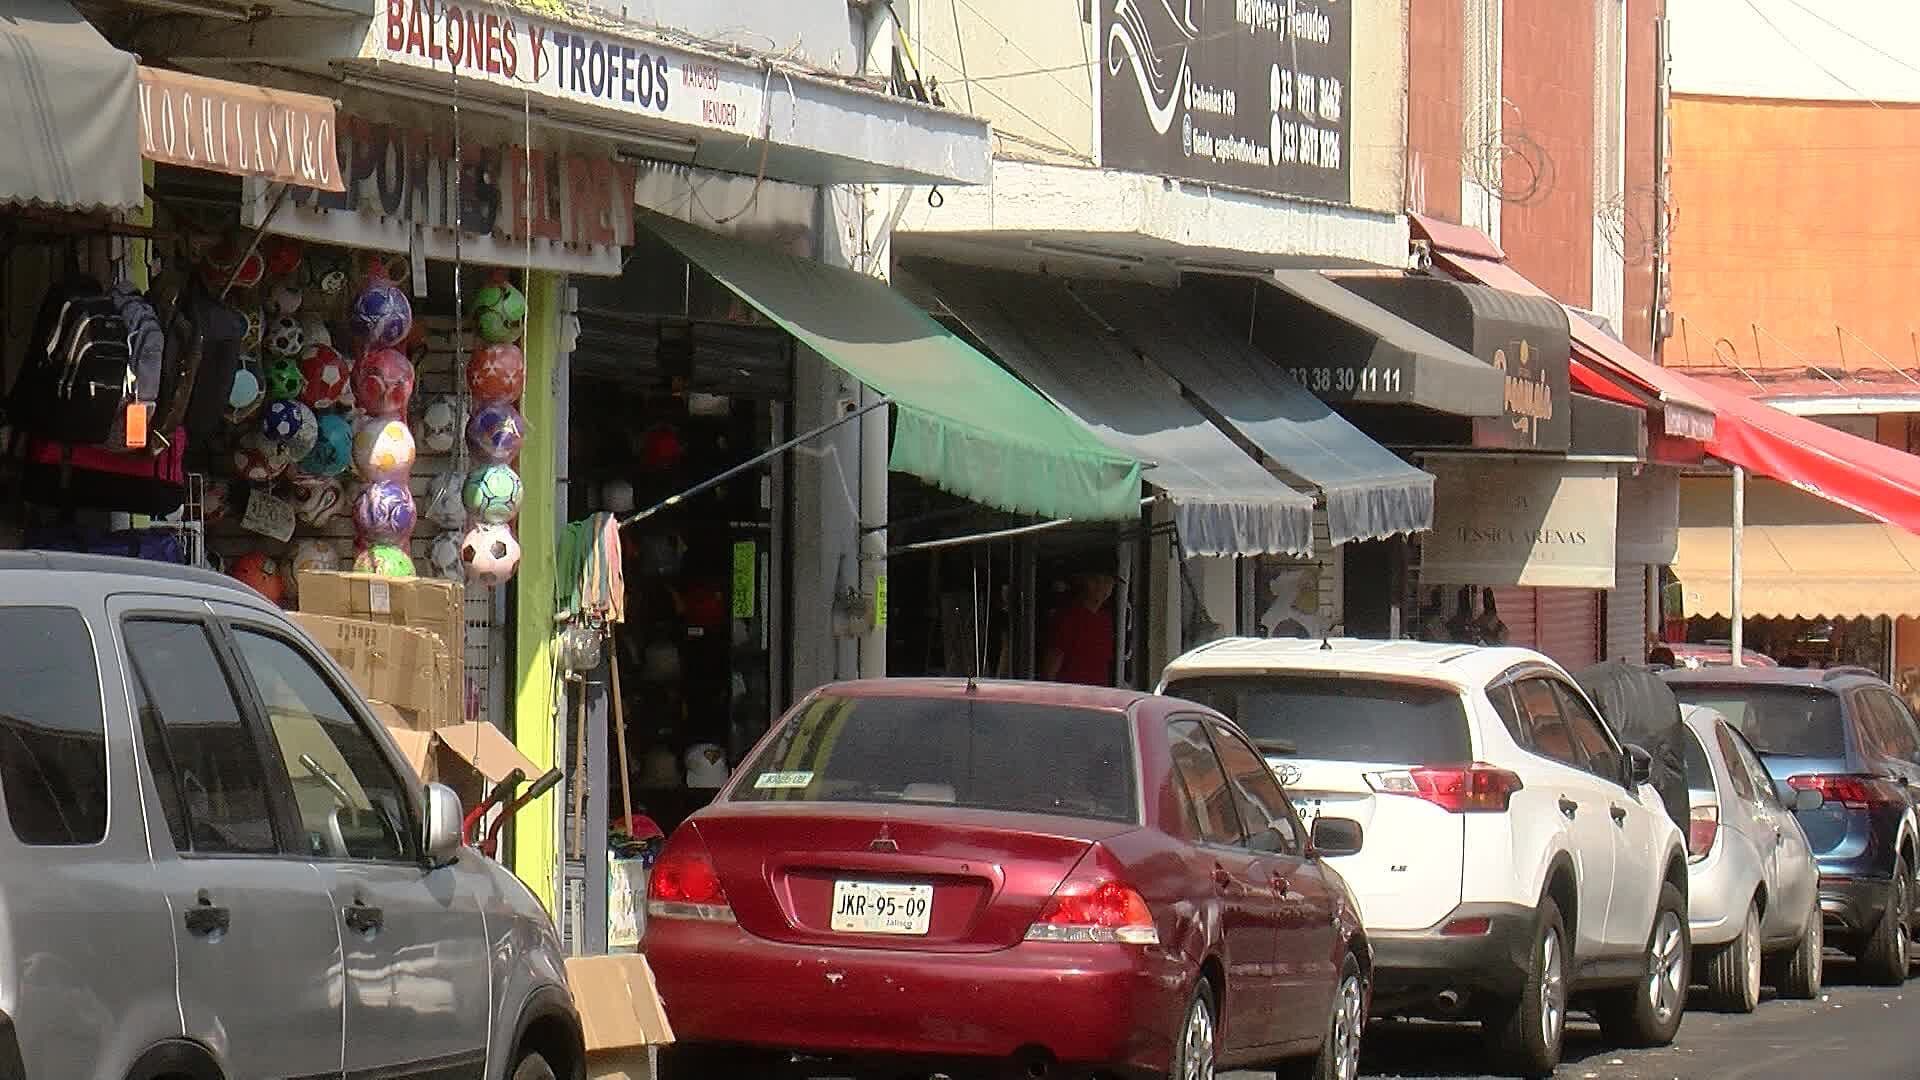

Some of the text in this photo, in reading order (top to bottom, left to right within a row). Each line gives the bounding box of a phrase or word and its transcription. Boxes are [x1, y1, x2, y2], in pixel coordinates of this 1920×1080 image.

[387, 0, 670, 112] BALONES Y TROFEOS
[682, 63, 719, 91] MAYOREO
[1281, 69, 1293, 110] 33
[702, 99, 737, 126] MENUDEO
[1311, 367, 1331, 392] 38
[1335, 367, 1354, 392] 30
[1359, 367, 1377, 392] 11
[1383, 367, 1401, 392] 11
[1523, 527, 1587, 545] ARENAS
[836, 894, 926, 918] JKR-95-09
